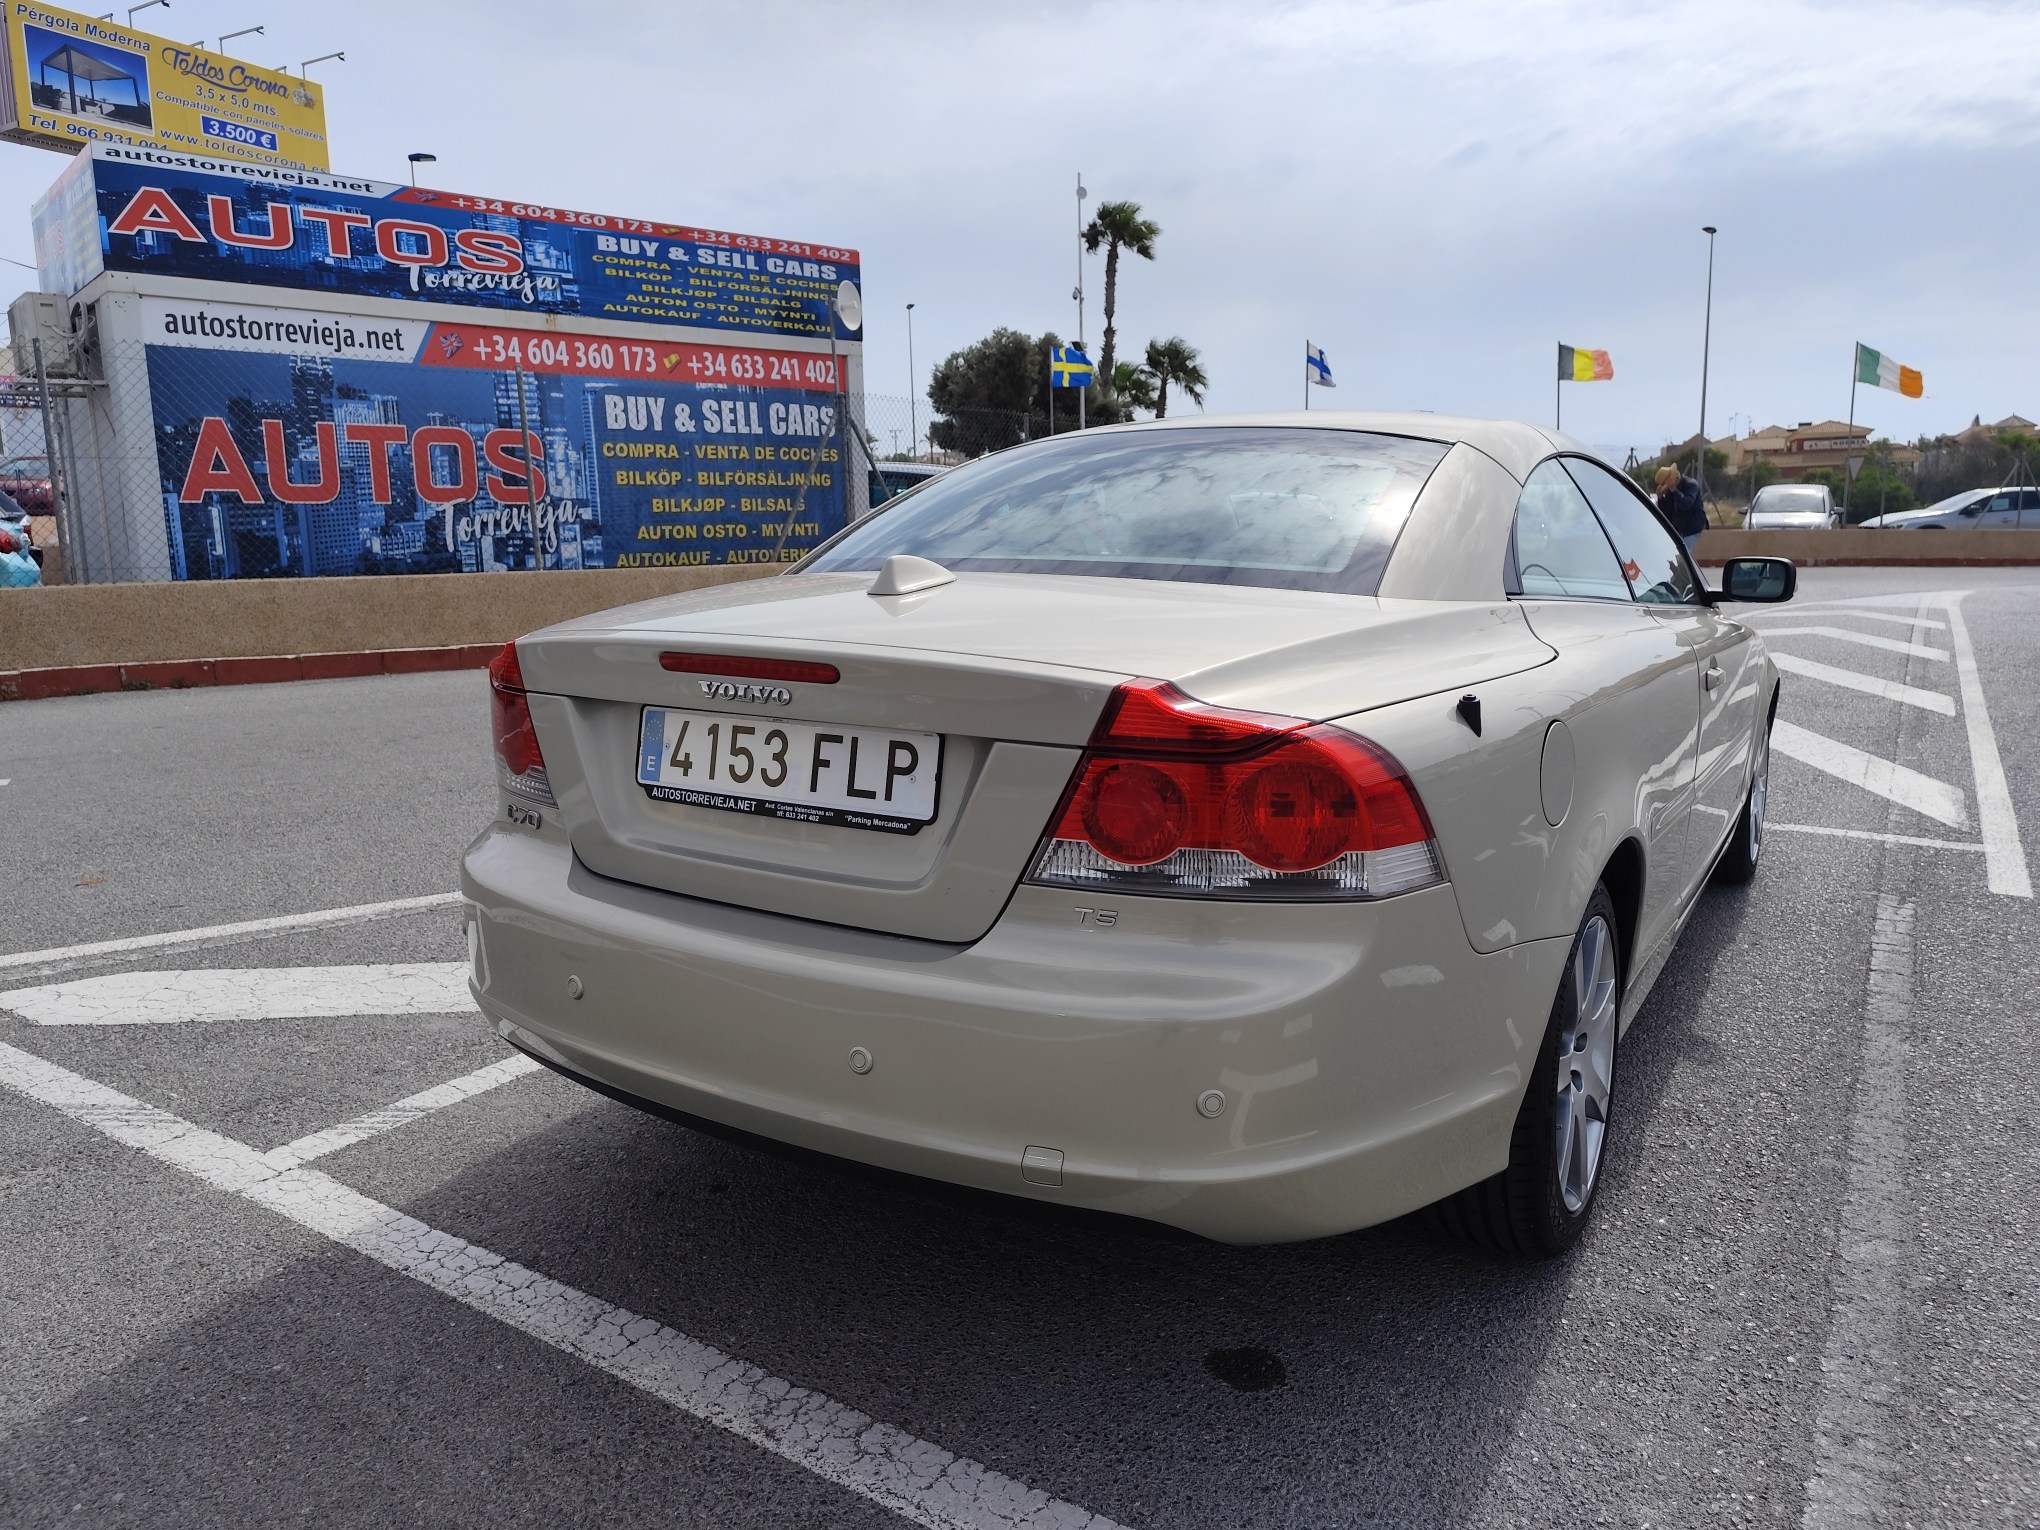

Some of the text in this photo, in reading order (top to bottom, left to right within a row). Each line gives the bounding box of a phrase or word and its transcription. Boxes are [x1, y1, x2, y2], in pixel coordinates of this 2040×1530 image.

[17, 4, 151, 51] Pérgola Moderna
[162, 47, 289, 99] Toldos Corona
[156, 91, 324, 142] Compatible con paneles solares
[195, 84, 280, 117] 3,5 x 5,0 mts.
[28, 114, 60, 132] Tel.
[66, 123, 99, 140] 966
[103, 131, 132, 145] 931
[208, 120, 272, 148] 3.500 €
[160, 129, 326, 174] www.toldoscoronaes
[105, 147, 374, 194] autostorrevieja.net
[108, 186, 524, 276] AUTOS
[451, 197, 850, 261] +34 604 360 173 +34 633 241 402
[592, 254, 671, 271] COMPRA
[687, 266, 744, 280] VENTA
[750, 274, 770, 284] DE
[776, 277, 839, 292] COCHES
[597, 234, 837, 281] BUY & SELL CARS
[400, 263, 559, 304] Torrevieja
[605, 267, 673, 282] BILKÖP
[689, 277, 829, 301] BILFÖRSÄLJNING
[641, 283, 718, 299] BILKJØP
[733, 293, 802, 308] BILSALG
[603, 302, 702, 319] AUTOKAUF
[625, 293, 688, 309] AUTON
[693, 300, 740, 313] OSTO
[754, 307, 816, 321] MYYNTI
[165, 311, 405, 352] autostorrevieja.net
[474, 334, 836, 385] +34 604 360 173 +34 633 241 402
[604, 394, 836, 437] BUY & SELL CARS
[179, 416, 547, 505] AUTOS
[602, 442, 679, 459] COMPRA
[695, 445, 750, 460] VENTA
[755, 446, 775, 460] DE
[616, 469, 682, 486] BILKÖP
[698, 469, 831, 487] BILFÖRSÄLJNNG
[652, 498, 726, 513] BILKJØP
[740, 498, 806, 513] BILSALG
[436, 496, 580, 553] Torrevieja
[637, 524, 697, 540] AUTON
[703, 523, 747, 538] OSTO
[761, 523, 819, 537] MYYNTI
[617, 550, 711, 568] AUTOKAUF
[698, 680, 792, 705] VOLVO
[646, 755, 656, 771] E
[669, 720, 919, 802] 4153 FLP
[651, 786, 757, 812] AUTOSTORREVIEJA.NET
[785, 811, 796, 819] 633
[797, 813, 807, 821] 241
[1074, 907, 1118, 927] T5
